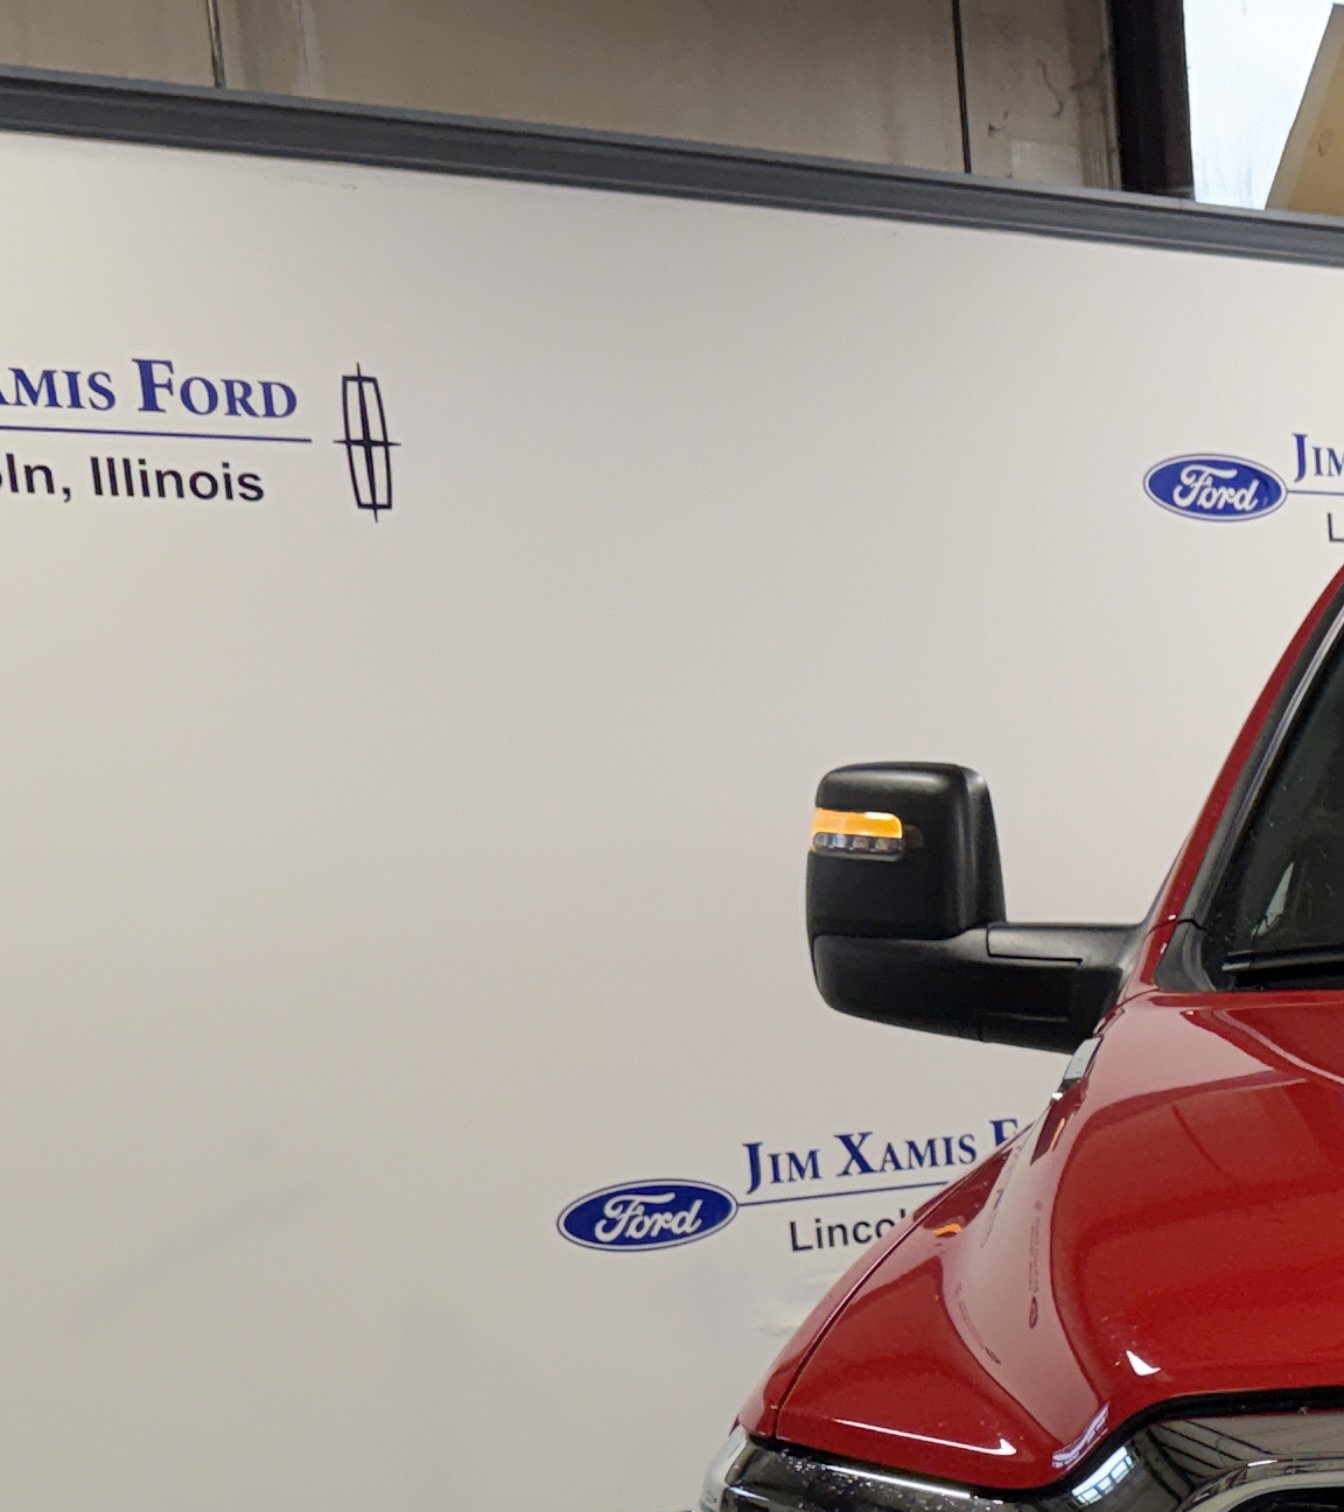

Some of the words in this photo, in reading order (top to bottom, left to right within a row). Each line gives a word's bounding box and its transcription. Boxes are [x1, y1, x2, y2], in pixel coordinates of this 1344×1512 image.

[0, 366, 116, 411] MIS
[131, 357, 298, 420] FORD
[90, 456, 265, 502] Illinois
[1172, 463, 1258, 511] Ford
[742, 1141, 823, 1195] JIM
[834, 1130, 978, 1178] XAMIS
[594, 1192, 703, 1242] Ford
